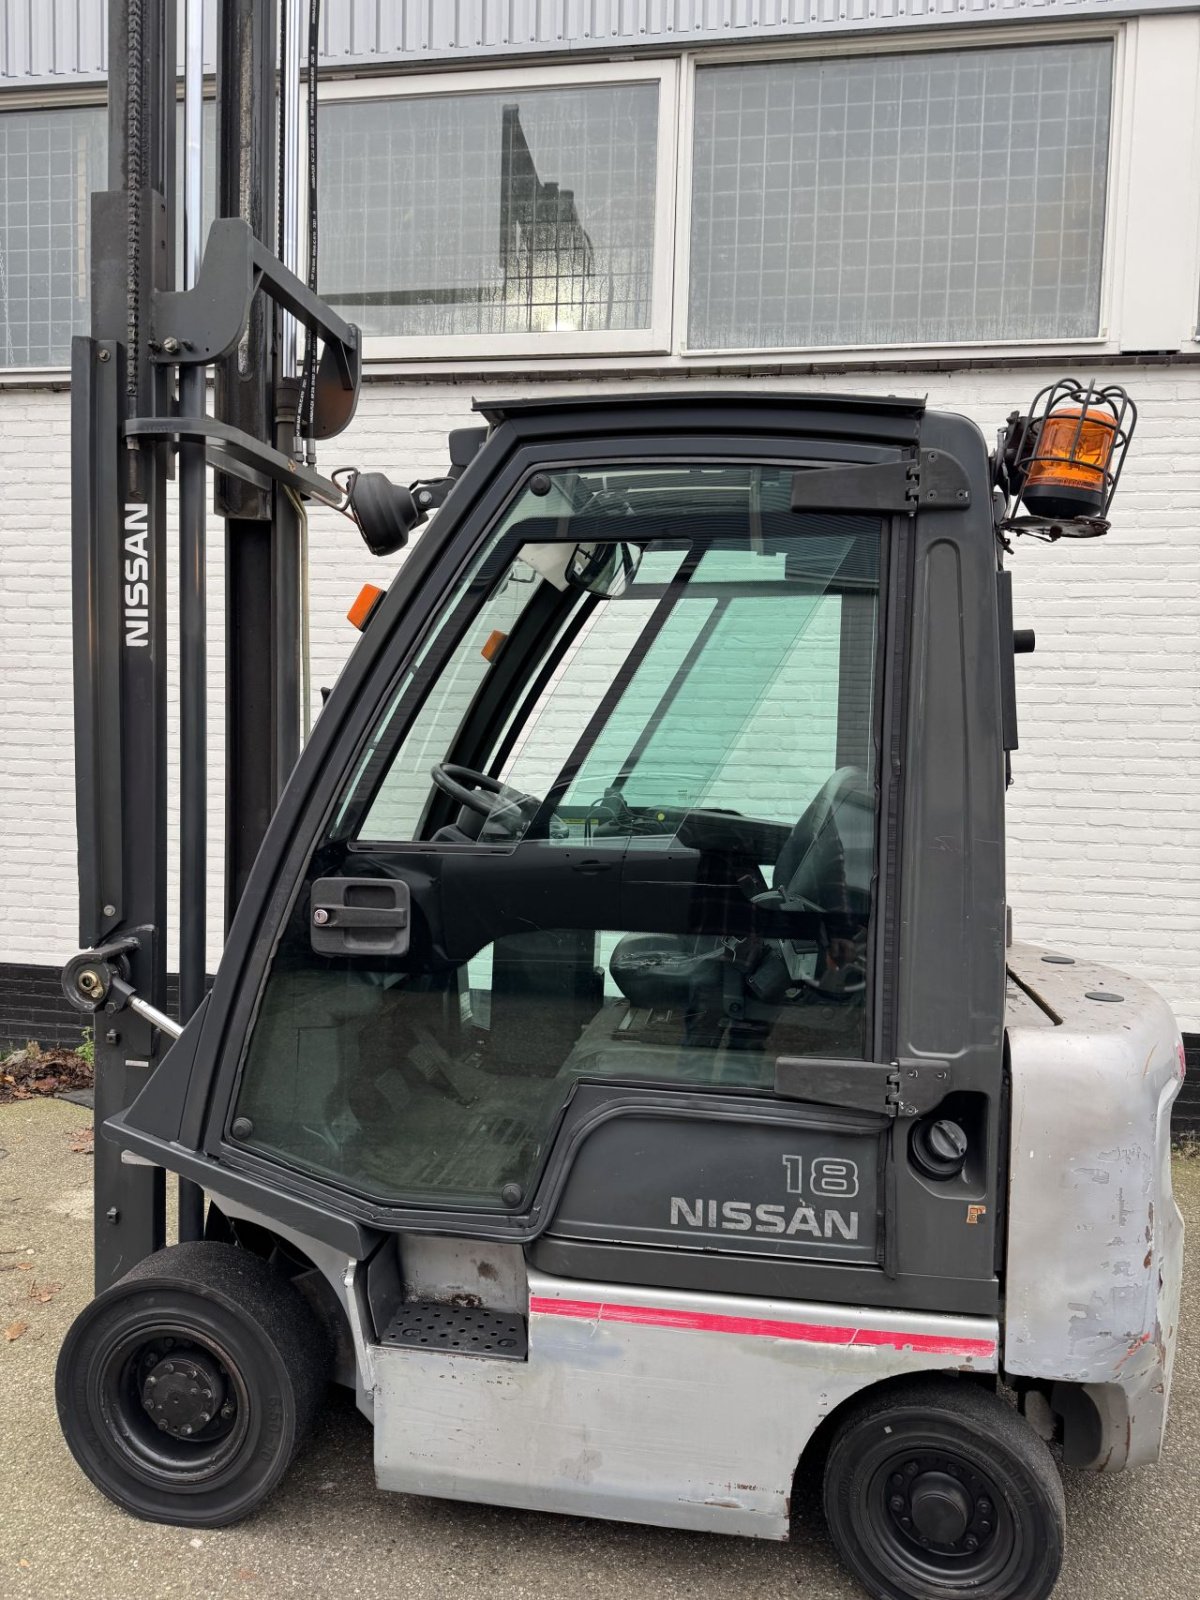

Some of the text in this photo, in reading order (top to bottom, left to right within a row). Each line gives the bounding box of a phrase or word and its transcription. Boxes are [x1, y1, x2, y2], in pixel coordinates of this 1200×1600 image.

[124, 503, 149, 647] NISSAN
[782, 1154, 859, 1197] 18
[670, 1196, 859, 1240] NISSAN
